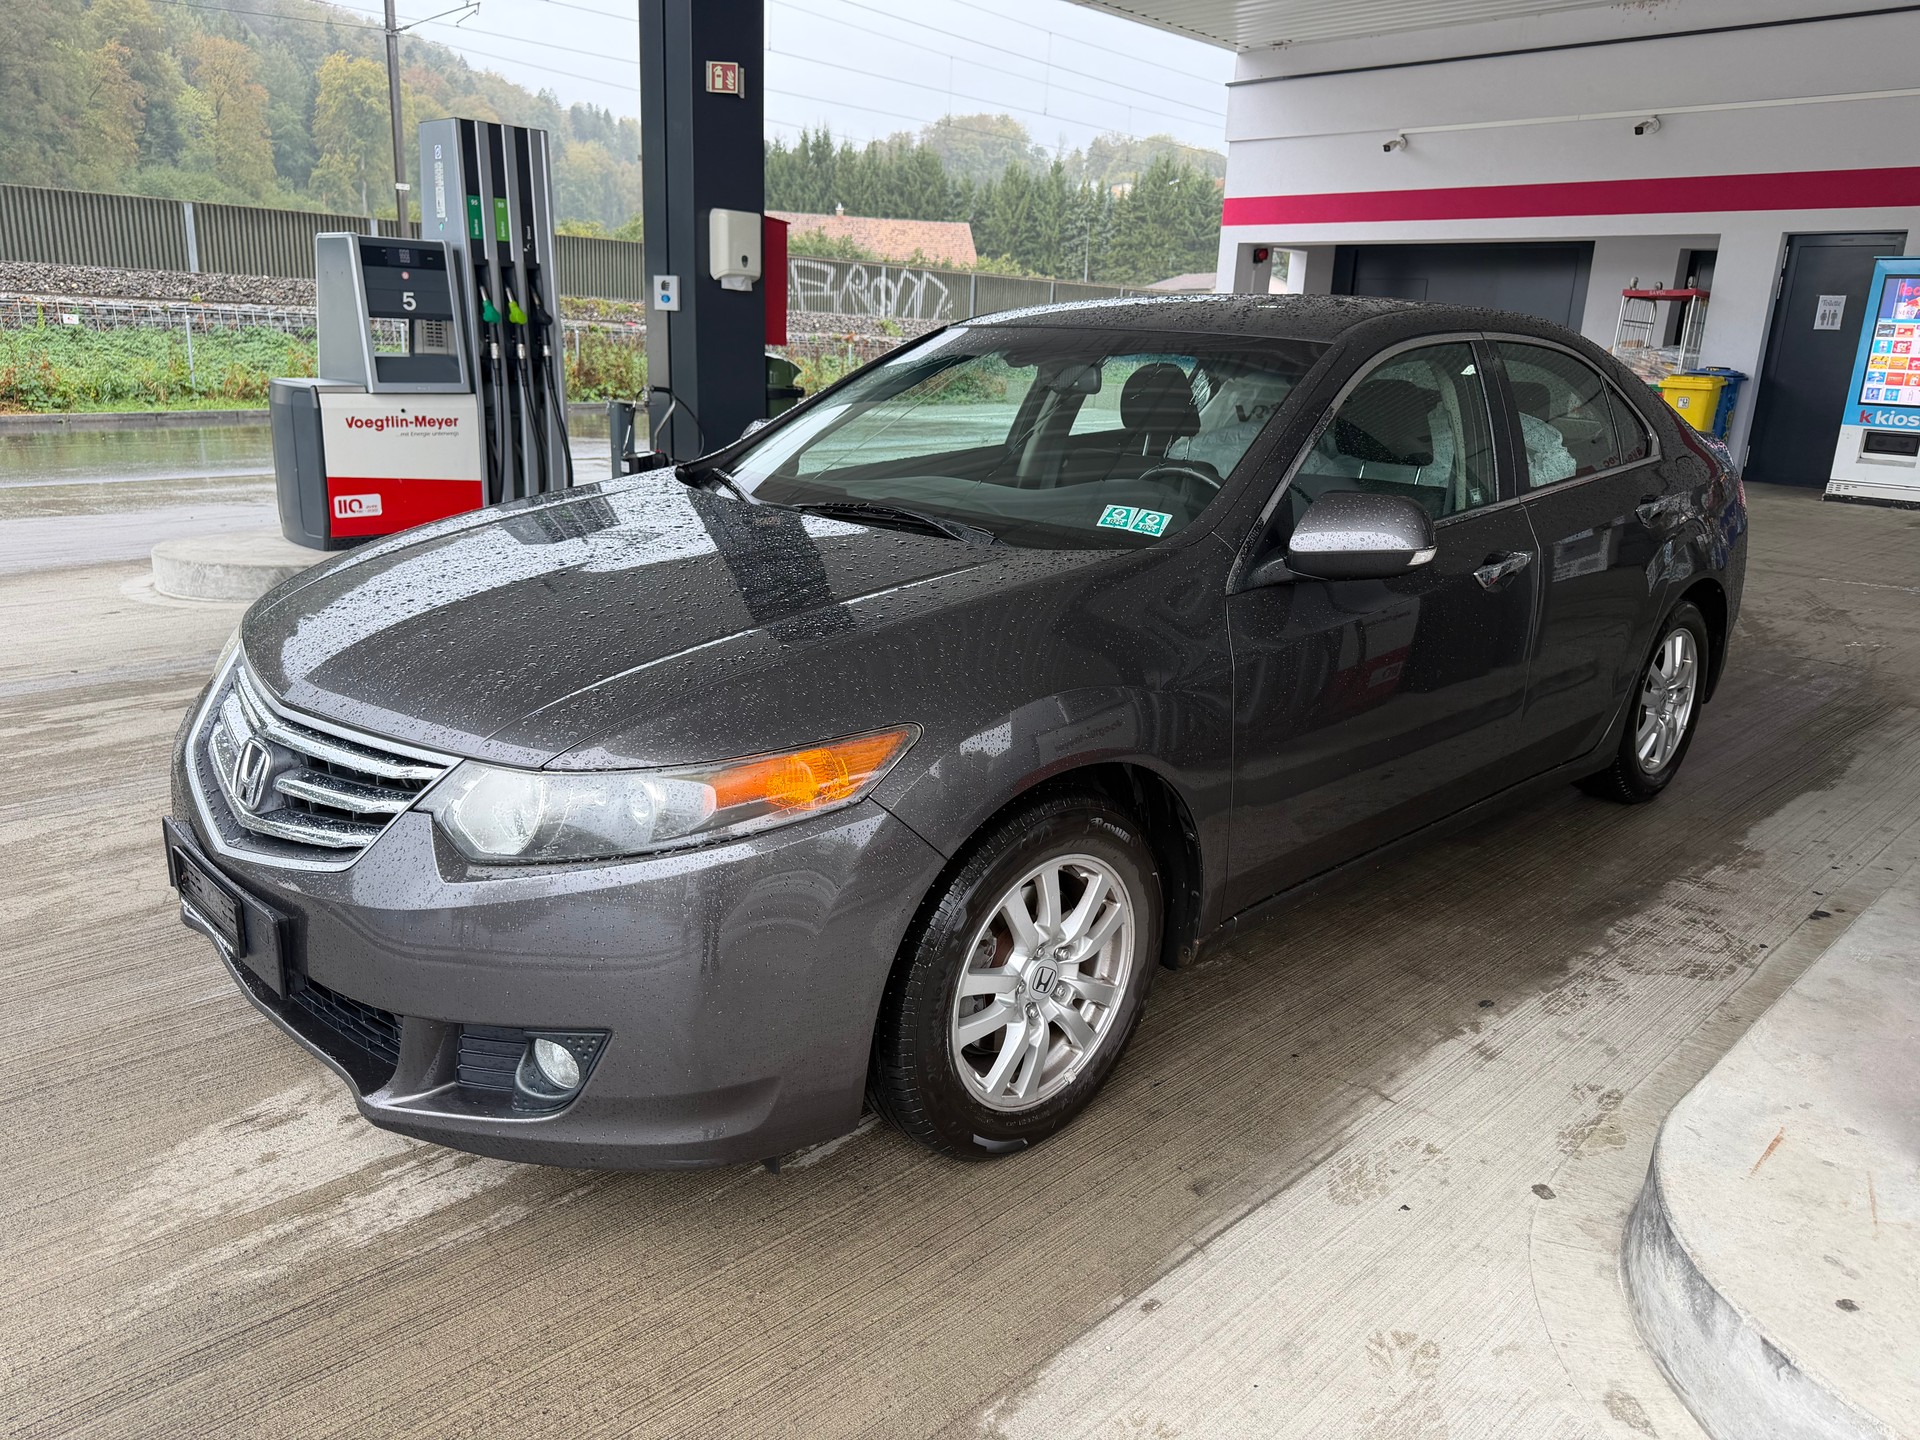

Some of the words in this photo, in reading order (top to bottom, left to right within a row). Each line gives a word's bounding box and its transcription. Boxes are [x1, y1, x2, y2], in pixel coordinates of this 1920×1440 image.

[402, 292, 417, 311] 5
[345, 415, 459, 432] Voegtlin-Meyer
[1875, 410, 1920, 427] kios
